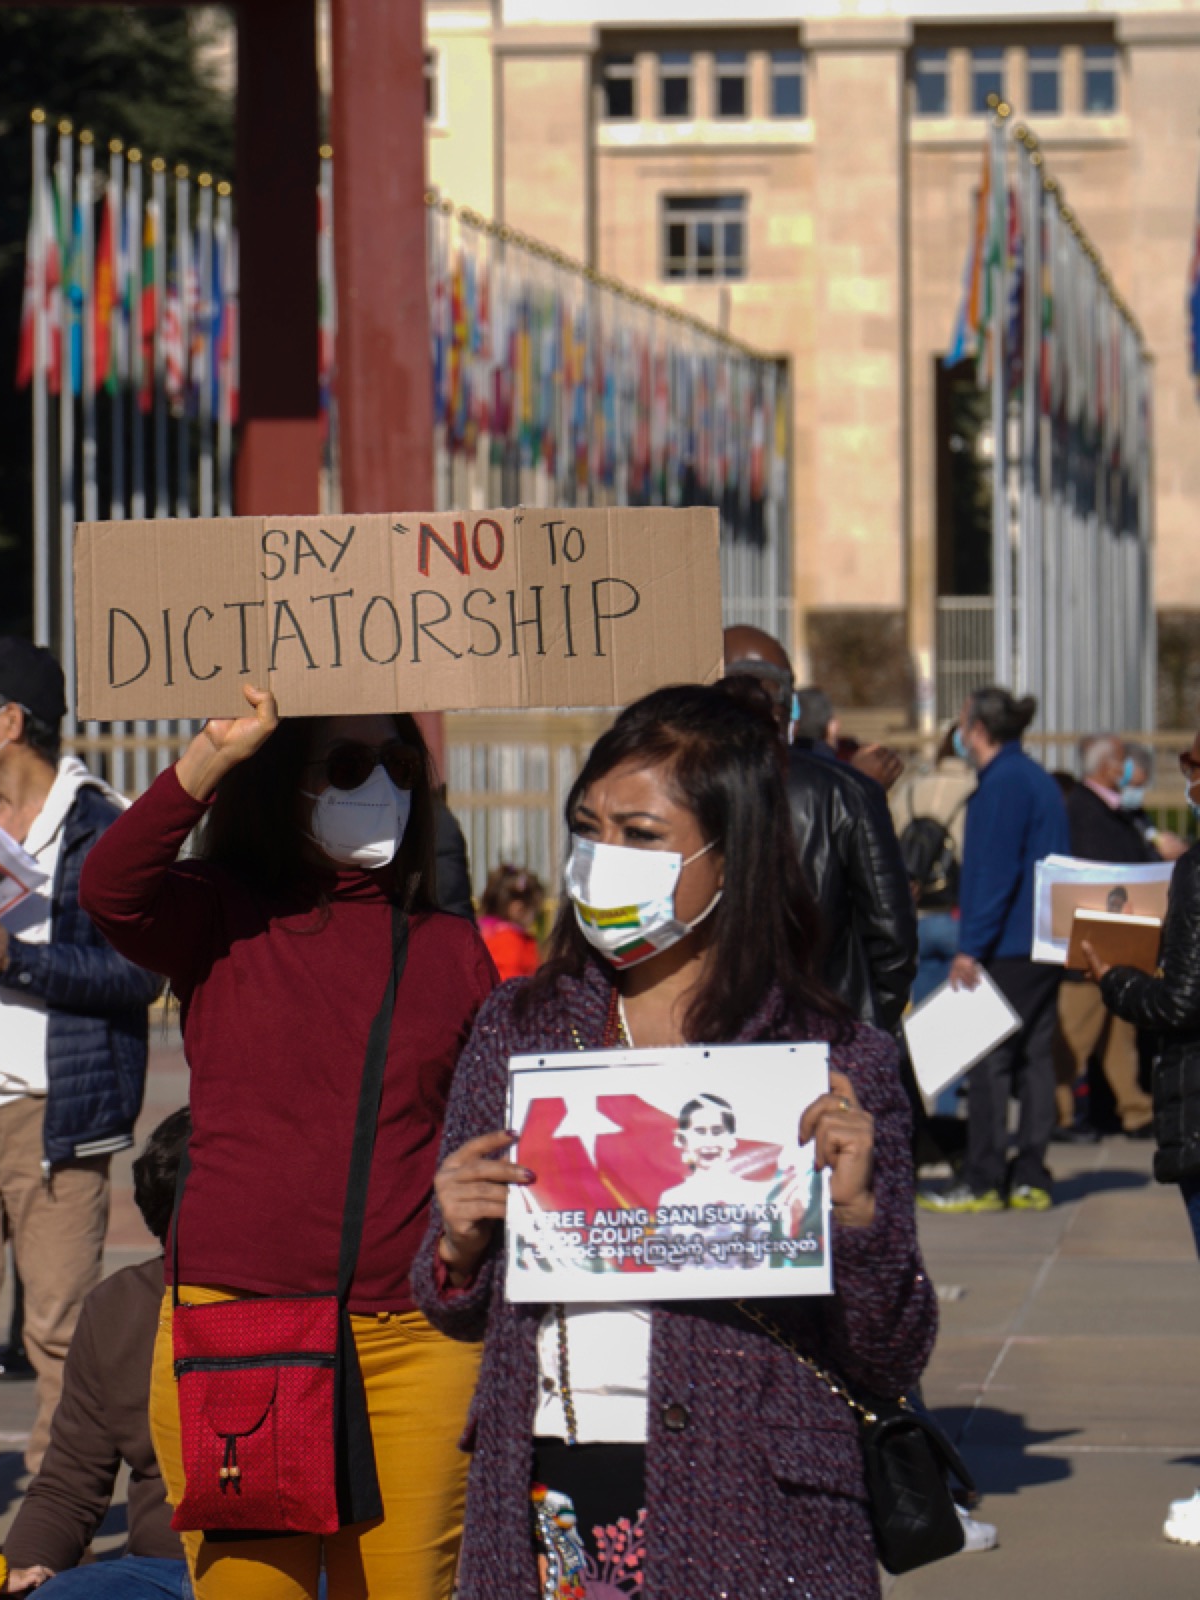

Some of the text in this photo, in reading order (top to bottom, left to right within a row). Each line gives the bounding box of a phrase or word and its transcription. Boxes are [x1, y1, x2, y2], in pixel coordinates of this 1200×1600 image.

[261, 526, 355, 580] SAY
[541, 521, 586, 566] TO
[108, 578, 640, 689] DICTATORSHIP
